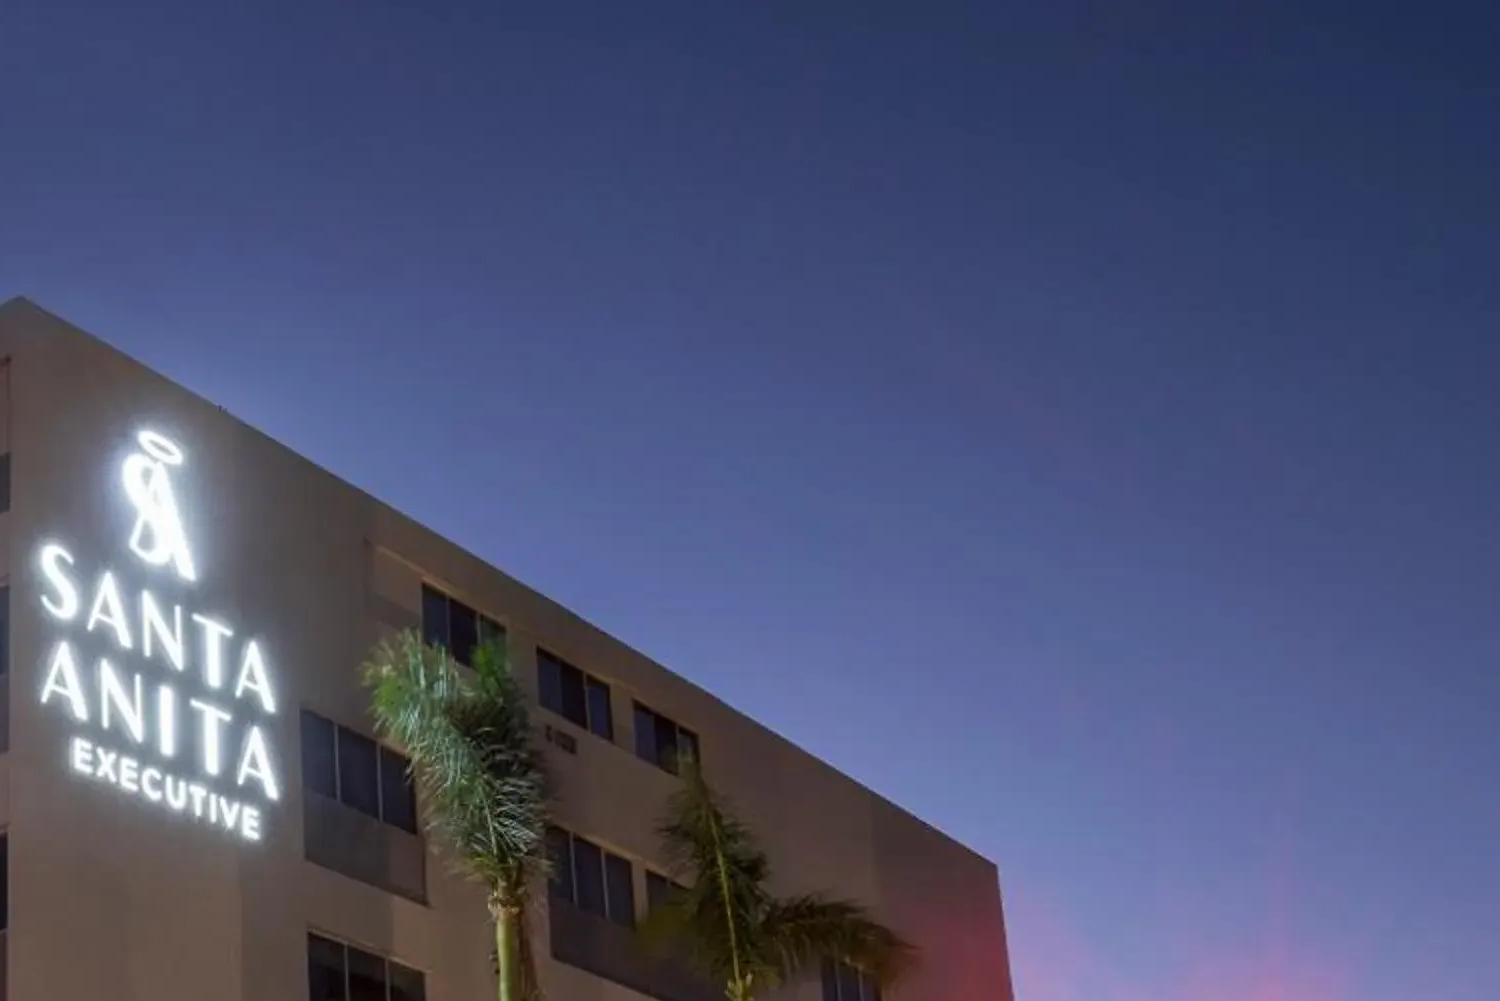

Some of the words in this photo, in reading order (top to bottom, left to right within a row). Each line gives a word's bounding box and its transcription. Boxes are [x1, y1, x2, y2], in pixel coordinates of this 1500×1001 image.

[39, 543, 277, 714] SANTA
[40, 639, 280, 802] ANITA
[73, 737, 262, 841] EXECUTIVE
